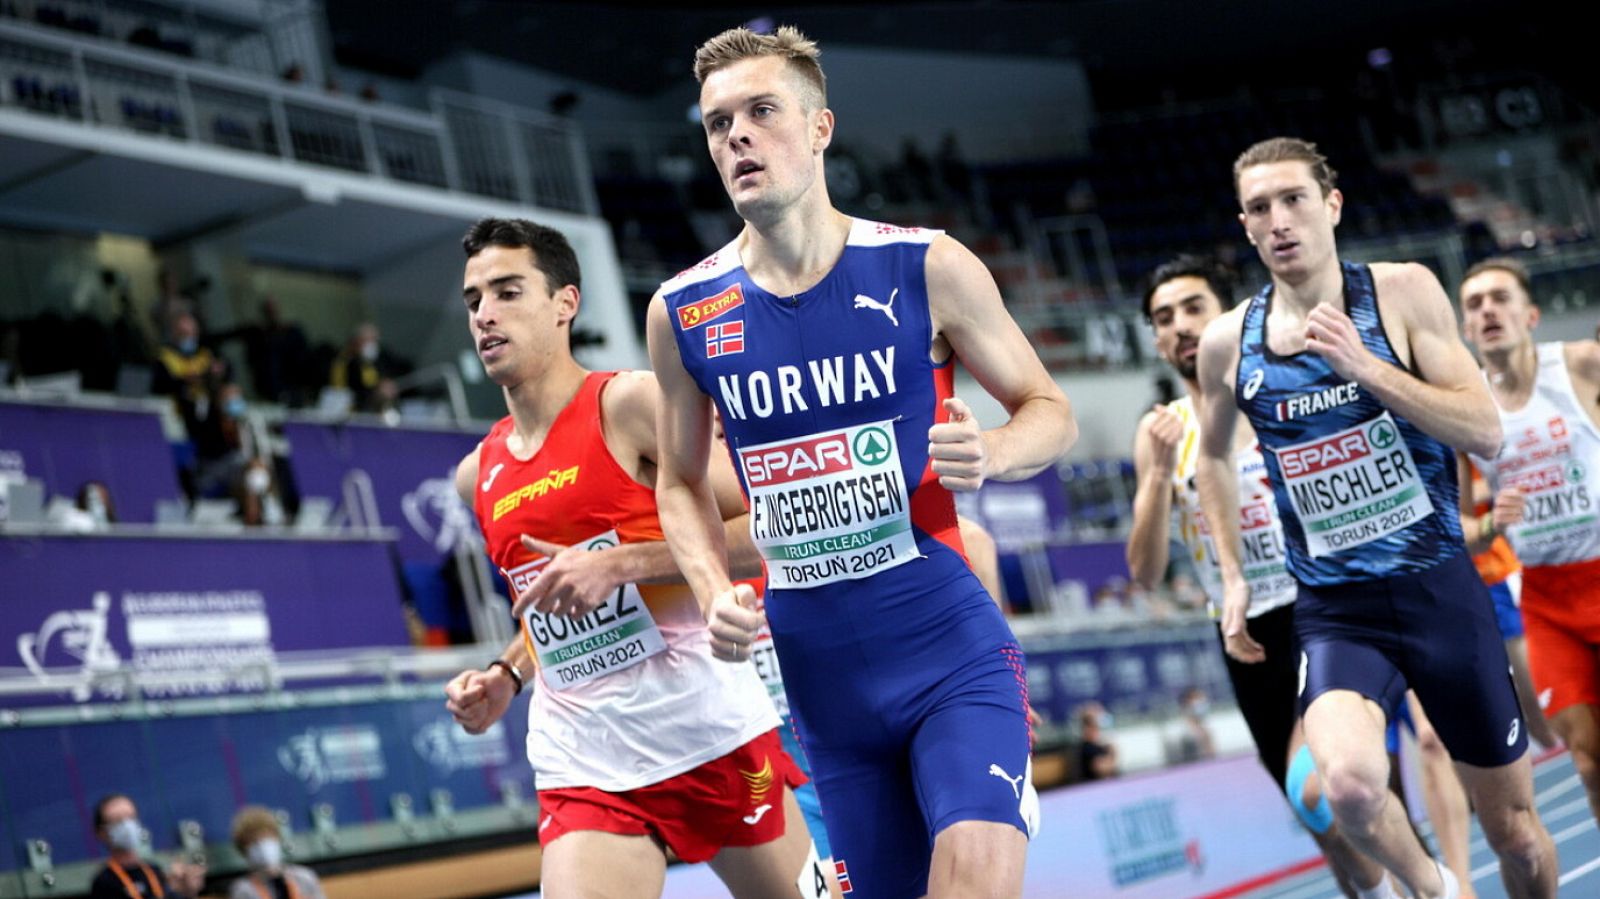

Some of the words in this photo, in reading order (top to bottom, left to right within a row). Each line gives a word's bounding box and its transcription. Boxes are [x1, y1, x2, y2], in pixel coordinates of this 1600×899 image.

[702, 291, 738, 315] EXTRA
[718, 345, 897, 421] NORWAY
[1286, 381, 1360, 420] FRANCE
[745, 440, 850, 483] SPAR
[1282, 434, 1367, 475] SPAR
[493, 465, 580, 521] ESPAÑA
[765, 470, 904, 538] INGEBRIGTSEN
[1292, 450, 1414, 517] MISCHLER
[1380, 505, 1416, 531] 2021
[1523, 486, 1591, 523] OZMYS
[782, 555, 848, 584] TORUŃ
[850, 543, 896, 573] 2021
[790, 543, 821, 558] RUN
[556, 653, 607, 684] TORUŃ
[606, 639, 647, 666] 2021
[559, 644, 583, 660] RUN
